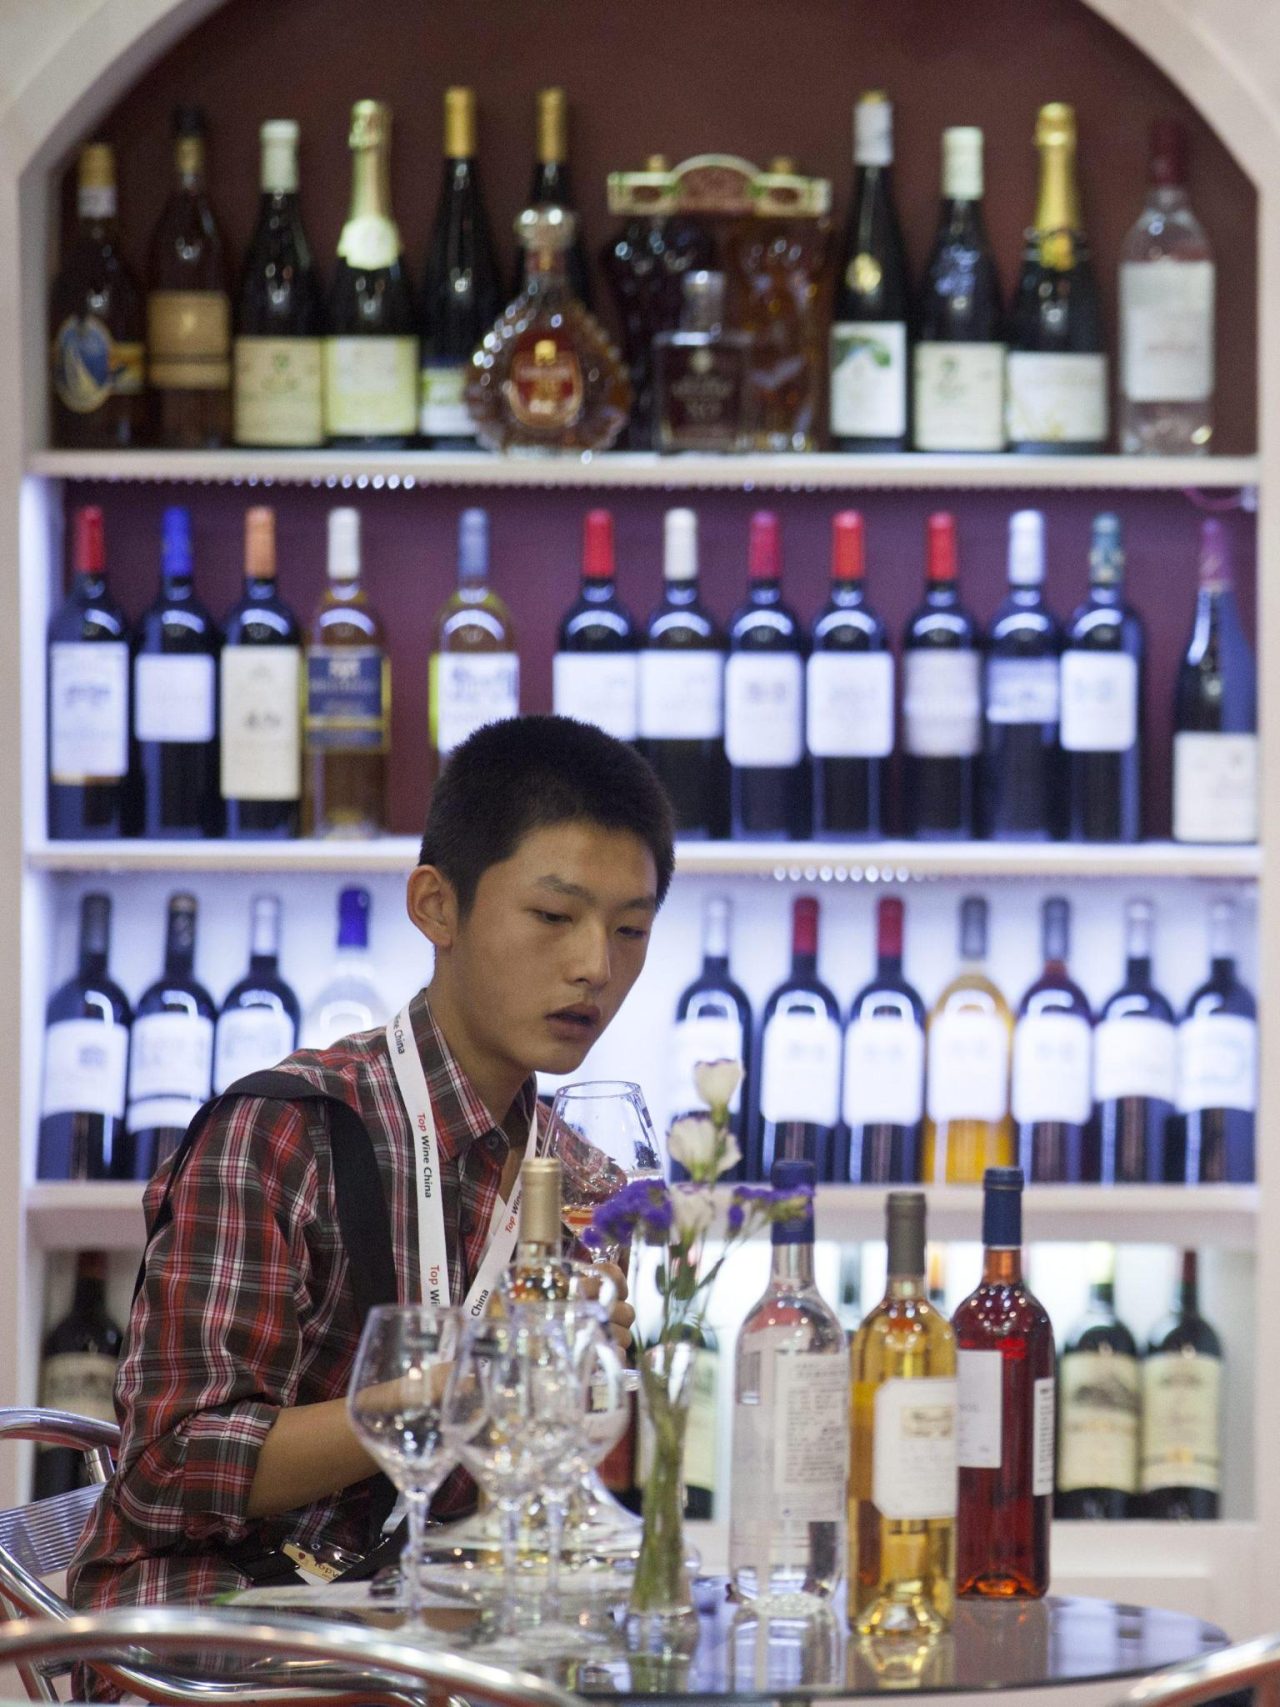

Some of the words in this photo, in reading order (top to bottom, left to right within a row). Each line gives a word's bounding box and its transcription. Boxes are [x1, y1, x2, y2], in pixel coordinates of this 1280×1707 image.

[394, 1029, 405, 1055] China
[417, 1112, 427, 1132] Top
[421, 1135, 431, 1164] Wine
[423, 1166, 433, 1198] China
[505, 1215, 516, 1233] Top
[428, 1264, 440, 1285] Top
[471, 1288, 489, 1317] China
